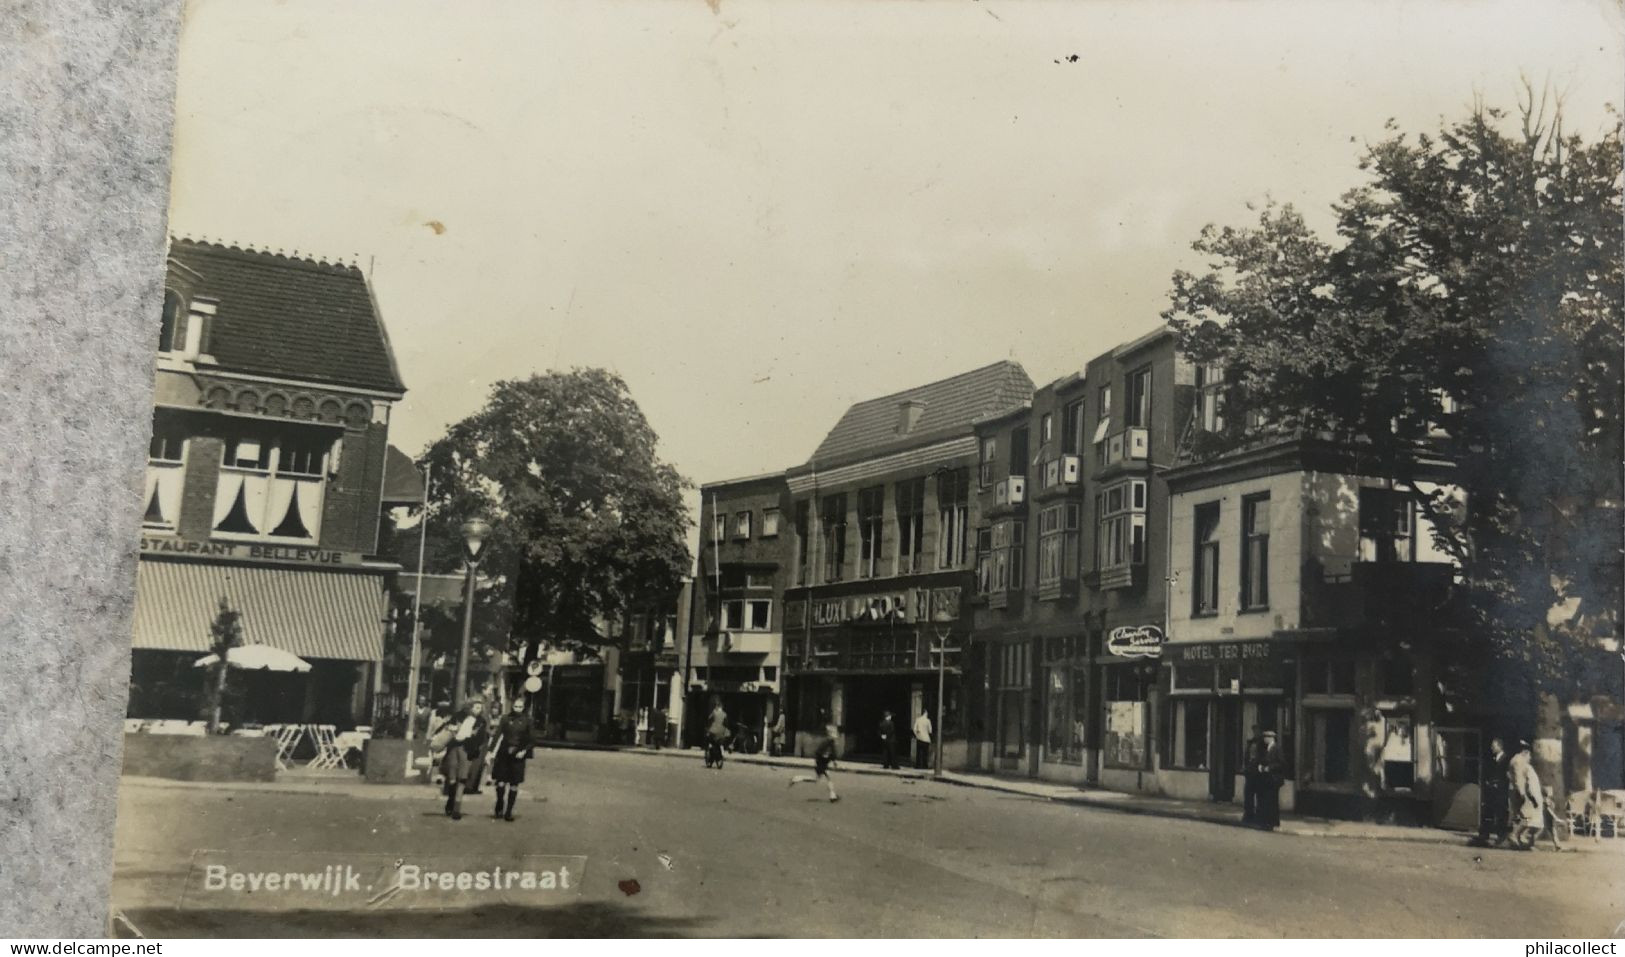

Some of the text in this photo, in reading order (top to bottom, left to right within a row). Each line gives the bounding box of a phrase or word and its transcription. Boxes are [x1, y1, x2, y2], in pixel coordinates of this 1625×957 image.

[249, 544, 342, 564] BELLEVUE
[1183, 644, 1215, 661] HOTEL
[1219, 644, 1238, 660] TER
